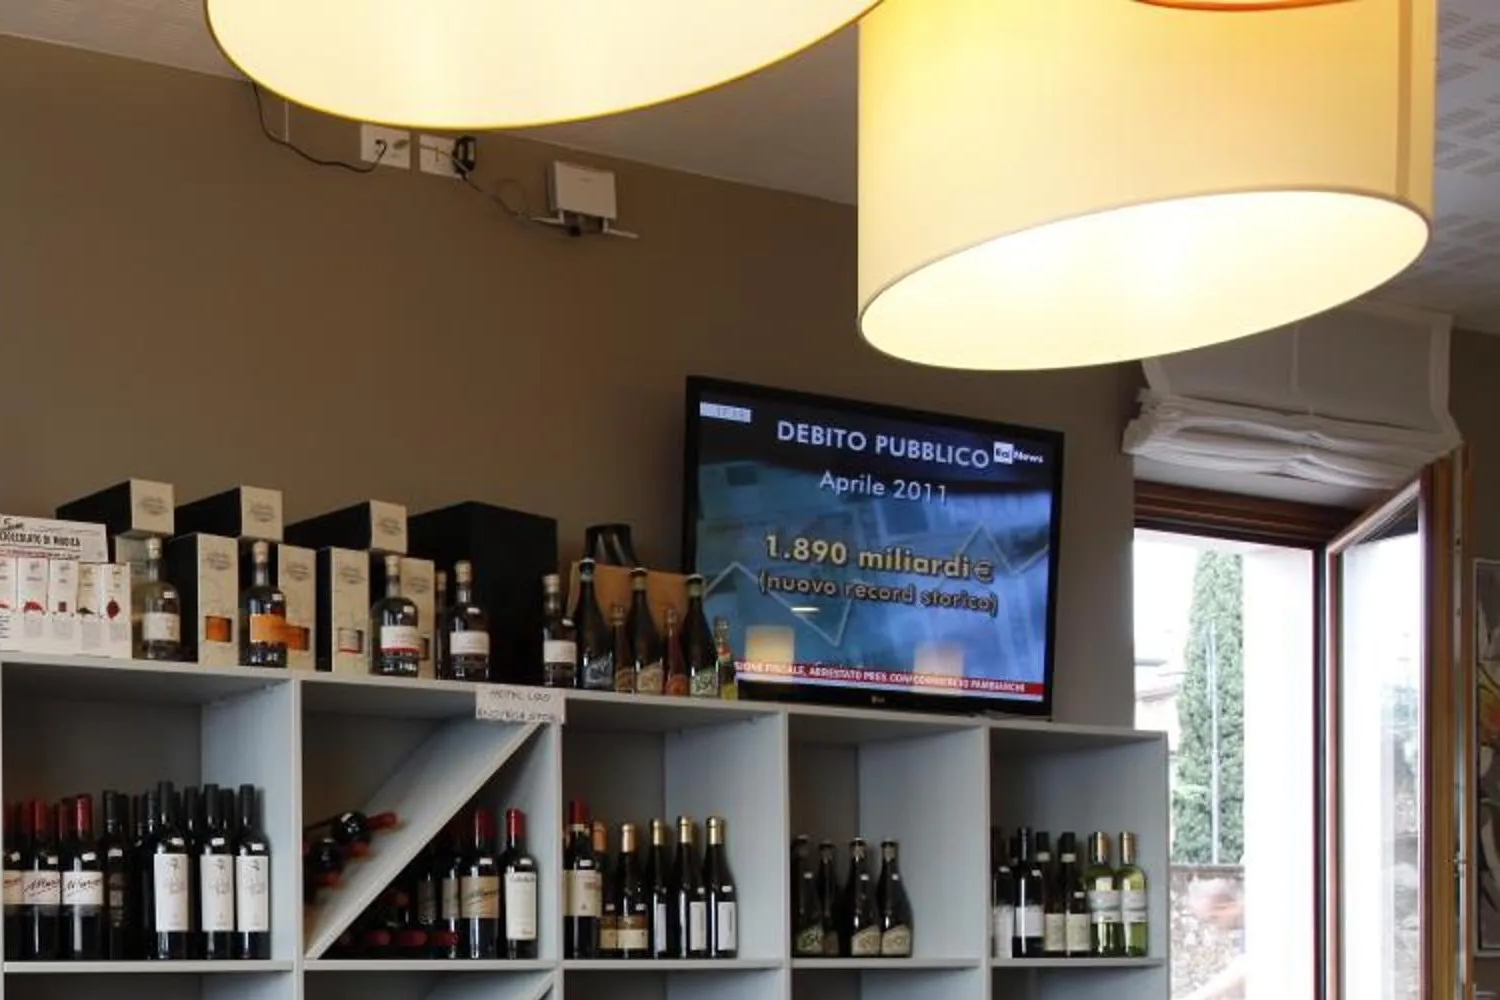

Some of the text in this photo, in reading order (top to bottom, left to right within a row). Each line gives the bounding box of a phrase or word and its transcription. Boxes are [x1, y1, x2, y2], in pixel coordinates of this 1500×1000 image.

[777, 420, 989, 468] DEBITO PUBBLICO
[819, 470, 947, 504] Aprile 2011
[764, 534, 848, 566] 1.890
[858, 547, 970, 581] miliardi
[758, 570, 999, 617] (nuovo record storico)
